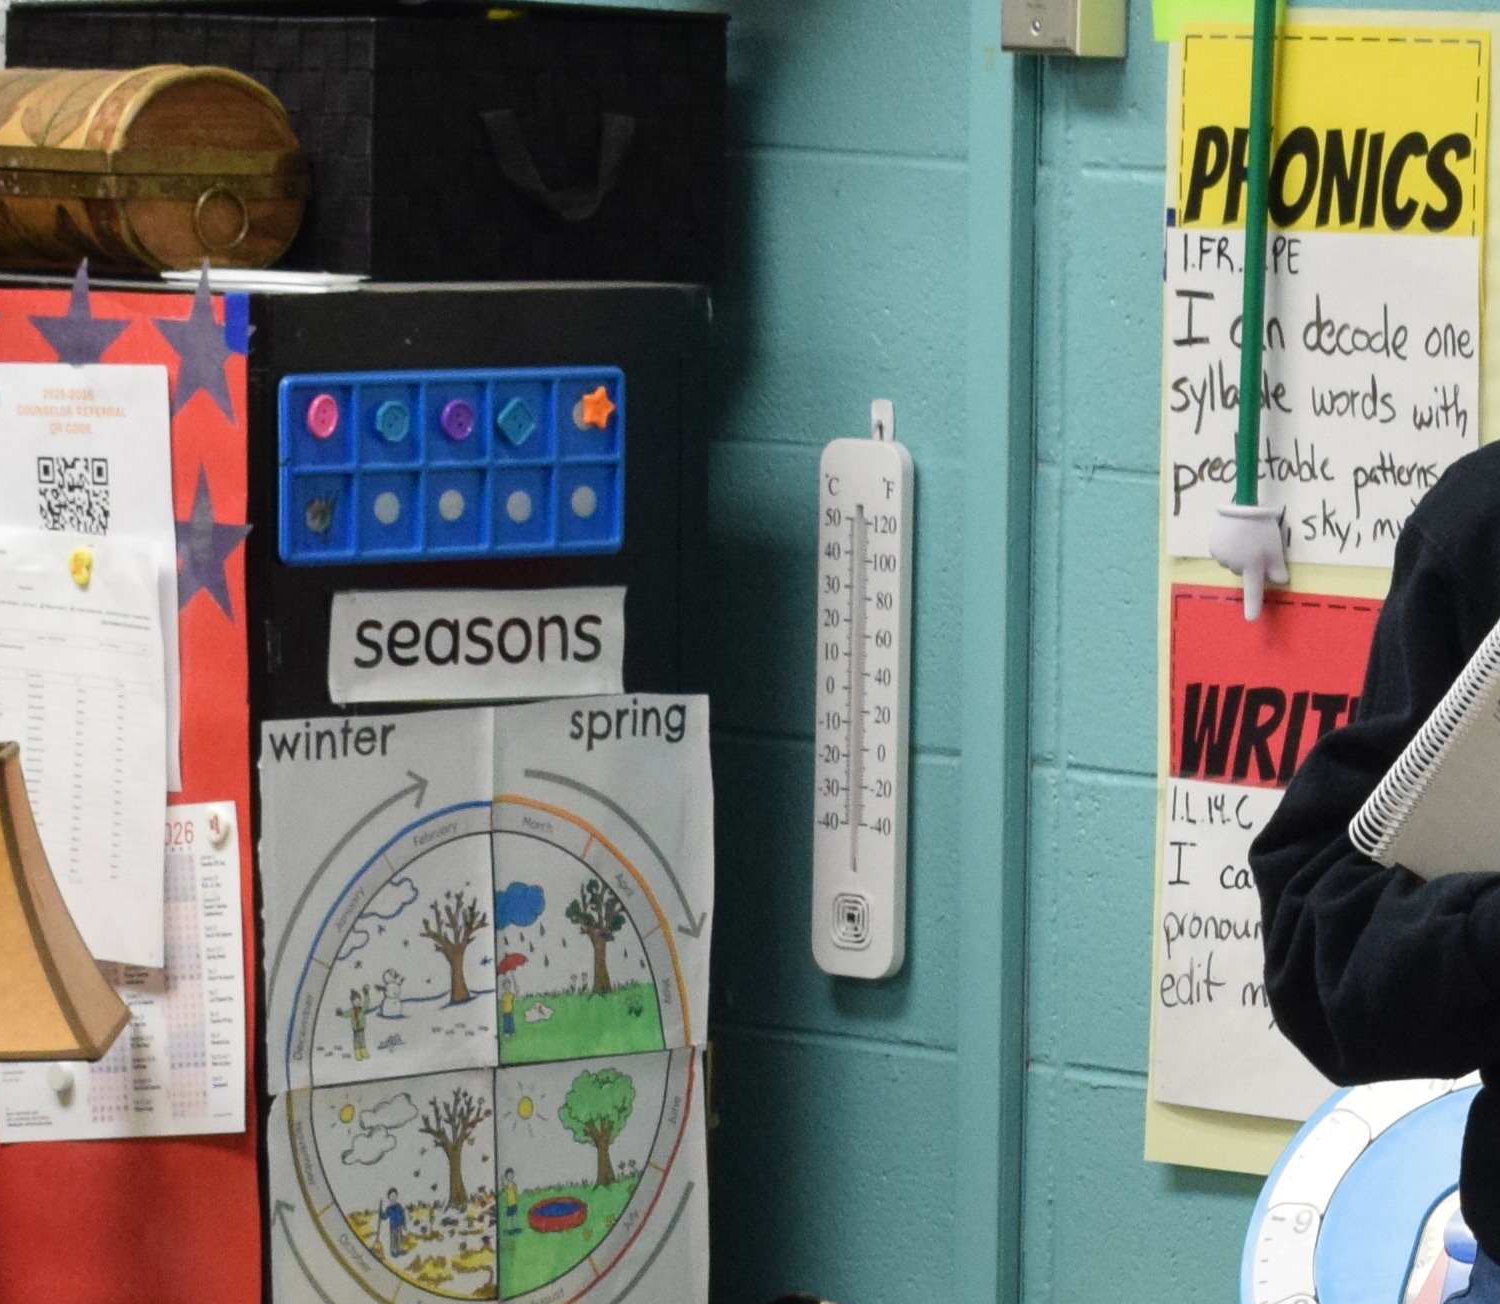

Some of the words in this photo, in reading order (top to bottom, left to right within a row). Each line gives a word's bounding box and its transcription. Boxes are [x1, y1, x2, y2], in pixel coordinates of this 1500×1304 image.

[1183, 124, 1473, 234] PHONICS
[1174, 288, 1214, 347] I
[1230, 313, 1285, 352] cn
[1303, 293, 1409, 359] decode
[1424, 325, 1475, 360] one
[1311, 373, 1396, 424] words
[1412, 384, 1468, 437] with
[1353, 450, 1440, 519] patterns
[825, 508, 841, 526] 50
[873, 515, 897, 534] 120
[824, 542, 841, 560] 40
[872, 553, 896, 572] 100
[824, 576, 841, 593] 30
[876, 592, 893, 610] 80
[823, 609, 840, 626] 20
[353, 612, 603, 669] seasons
[875, 630, 892, 648] 60
[823, 642, 840, 660] 10
[825, 677, 835, 695] 0
[874, 668, 891, 686] 40
[874, 706, 891, 724] 20
[568, 699, 688, 751] spring
[1180, 682, 1361, 787] WRIT
[269, 716, 395, 761] winter
[876, 744, 886, 762] 0
[522, 814, 554, 834] March
[1168, 841, 1198, 886] I
[1219, 864, 1255, 890] ca
[1160, 951, 1227, 1009] edit
[1292, 1208, 1314, 1235] 9
